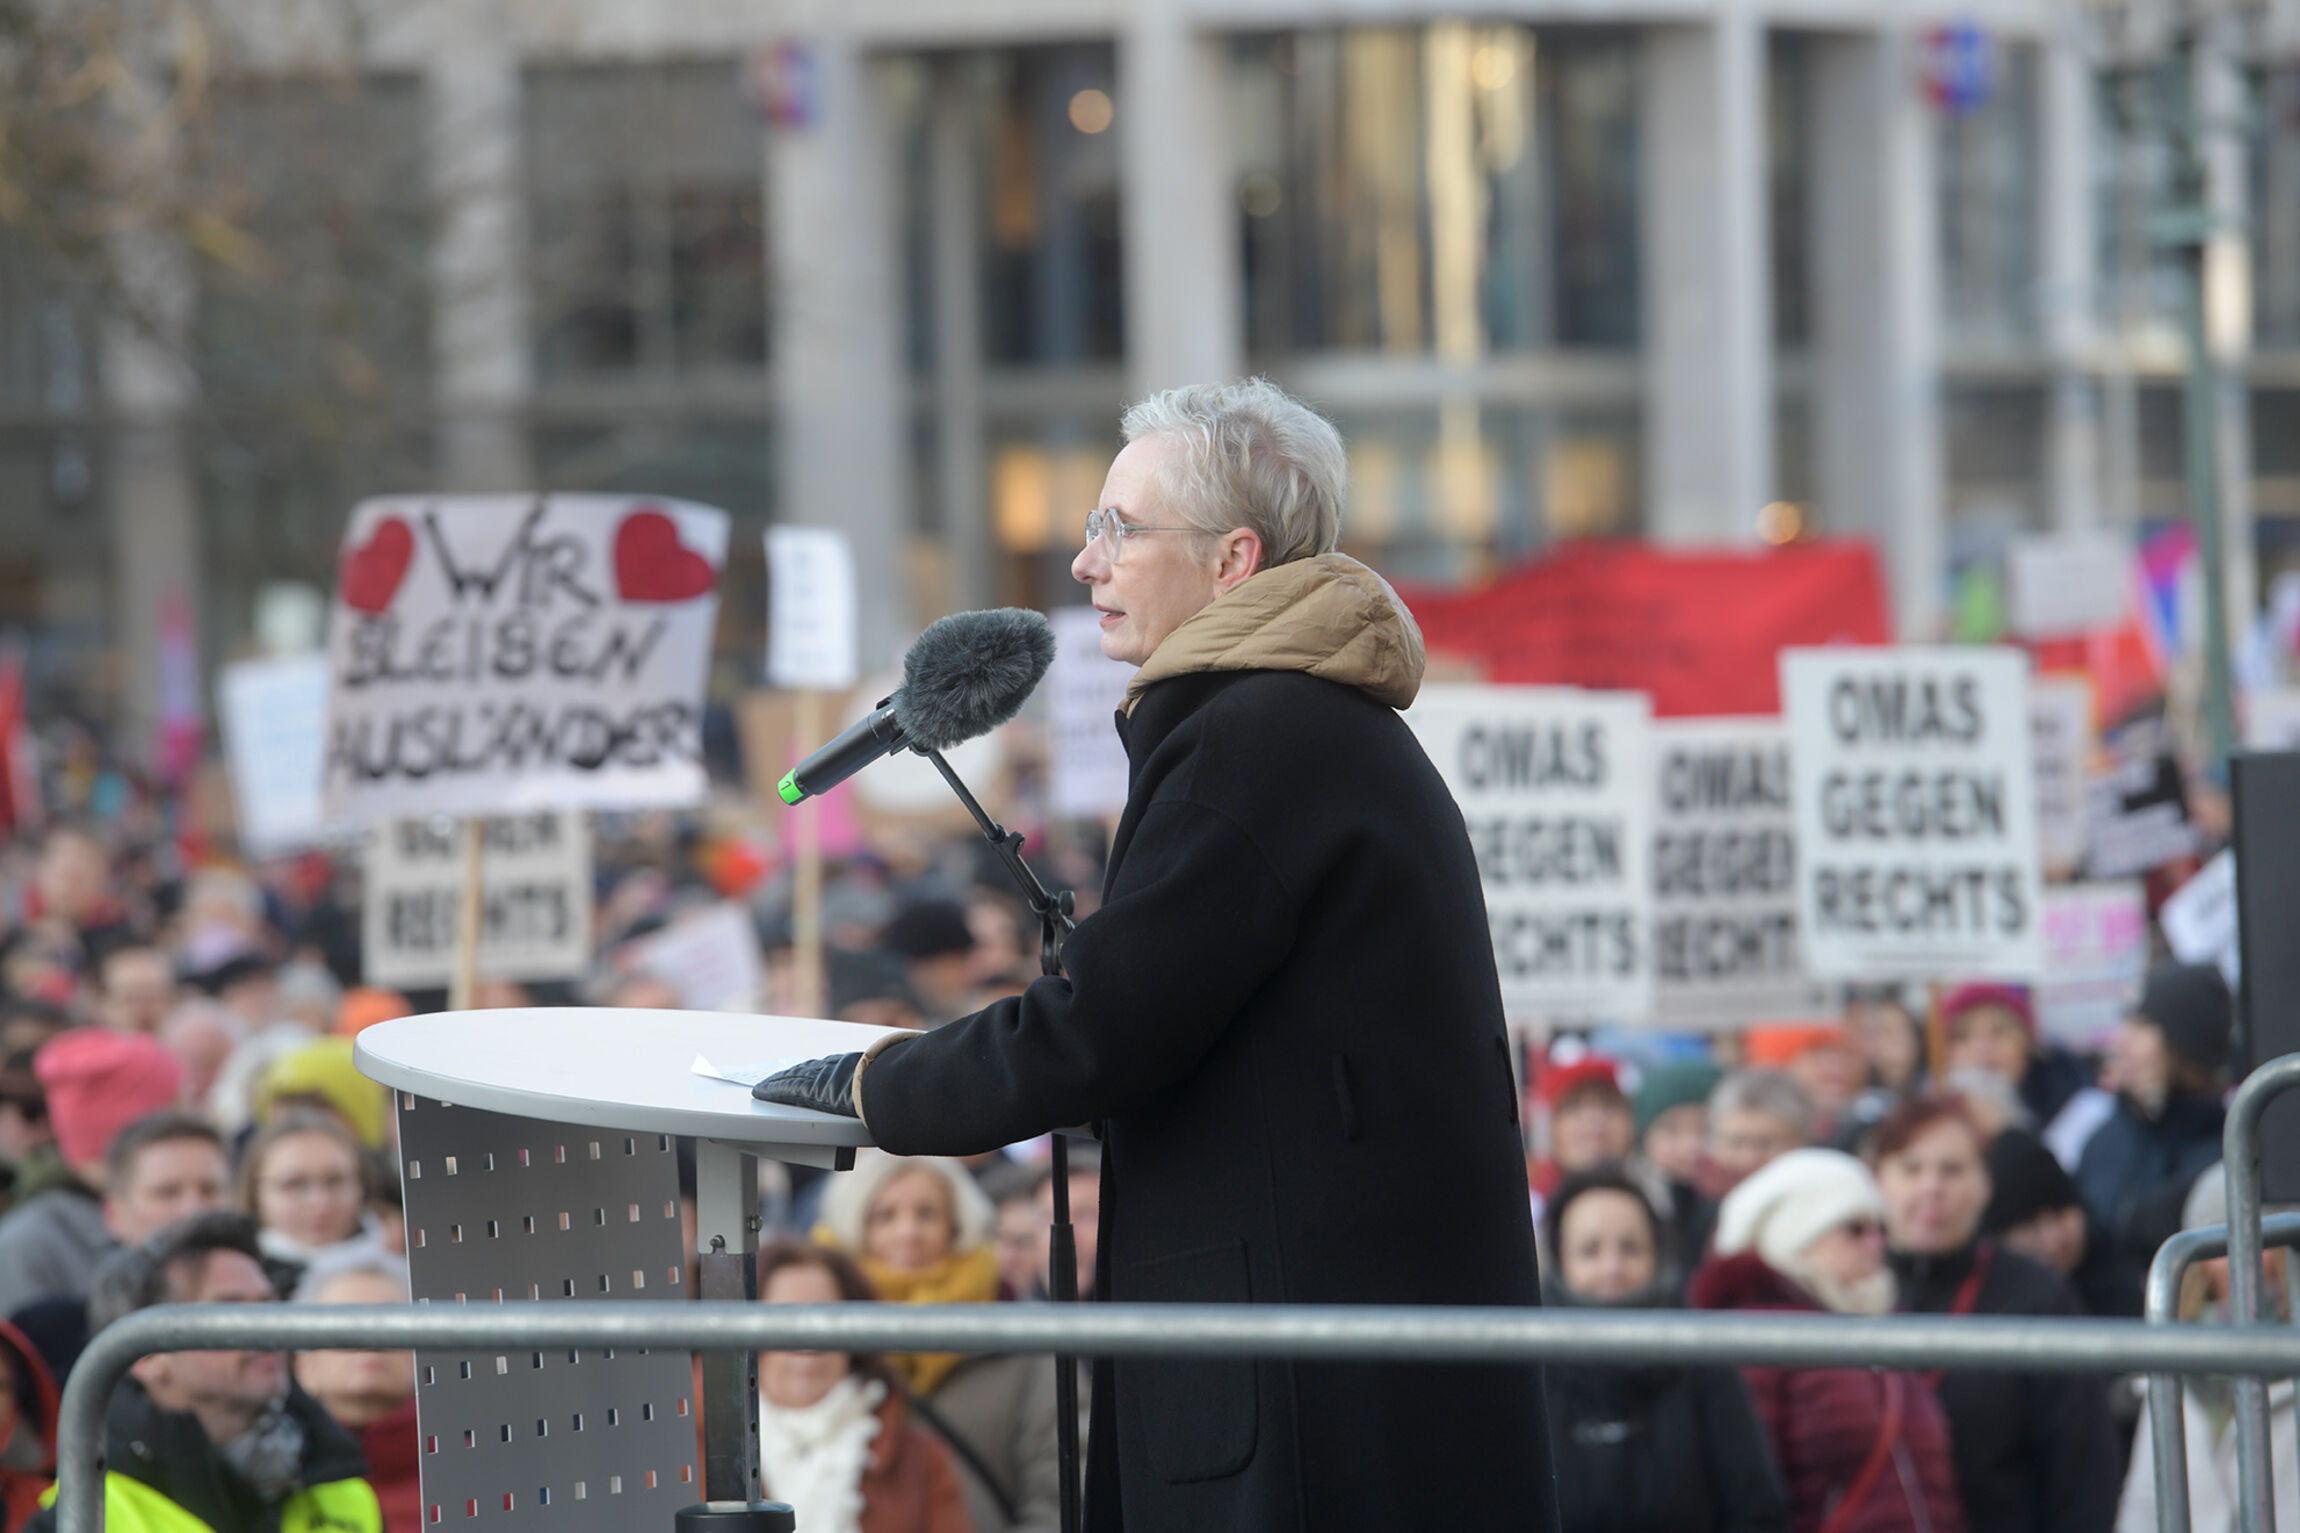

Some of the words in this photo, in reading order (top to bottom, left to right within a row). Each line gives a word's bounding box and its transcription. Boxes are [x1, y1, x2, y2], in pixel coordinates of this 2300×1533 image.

[1826, 672, 1983, 745] OMAS
[1459, 719, 1609, 790] OMAS
[1818, 768, 2006, 839] GEGEN
[1467, 815, 1624, 887] EGEN
[1813, 866, 2029, 933] RECHTS
